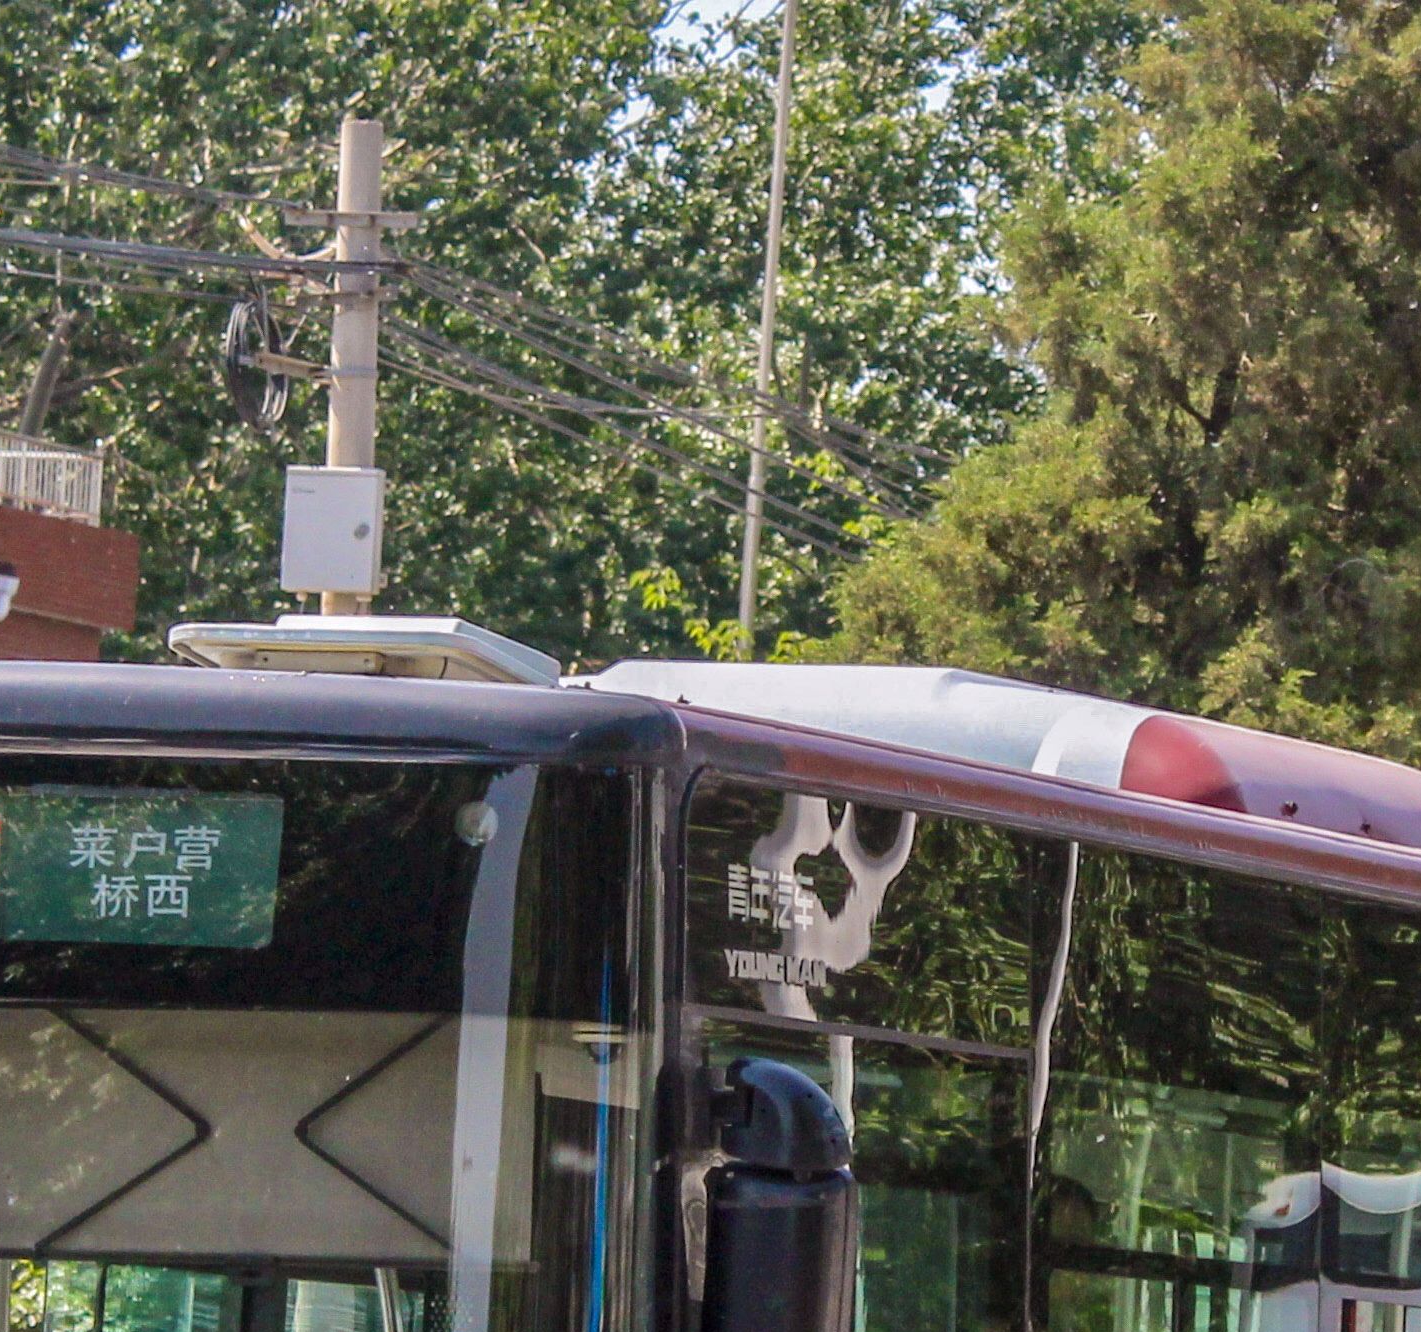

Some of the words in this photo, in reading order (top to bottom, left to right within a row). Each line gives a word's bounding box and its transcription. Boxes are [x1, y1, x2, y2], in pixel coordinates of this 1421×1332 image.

[69, 821, 221, 872] 菜户营
[90, 873, 193, 919] 桥西
[727, 862, 815, 932] 青年汽车
